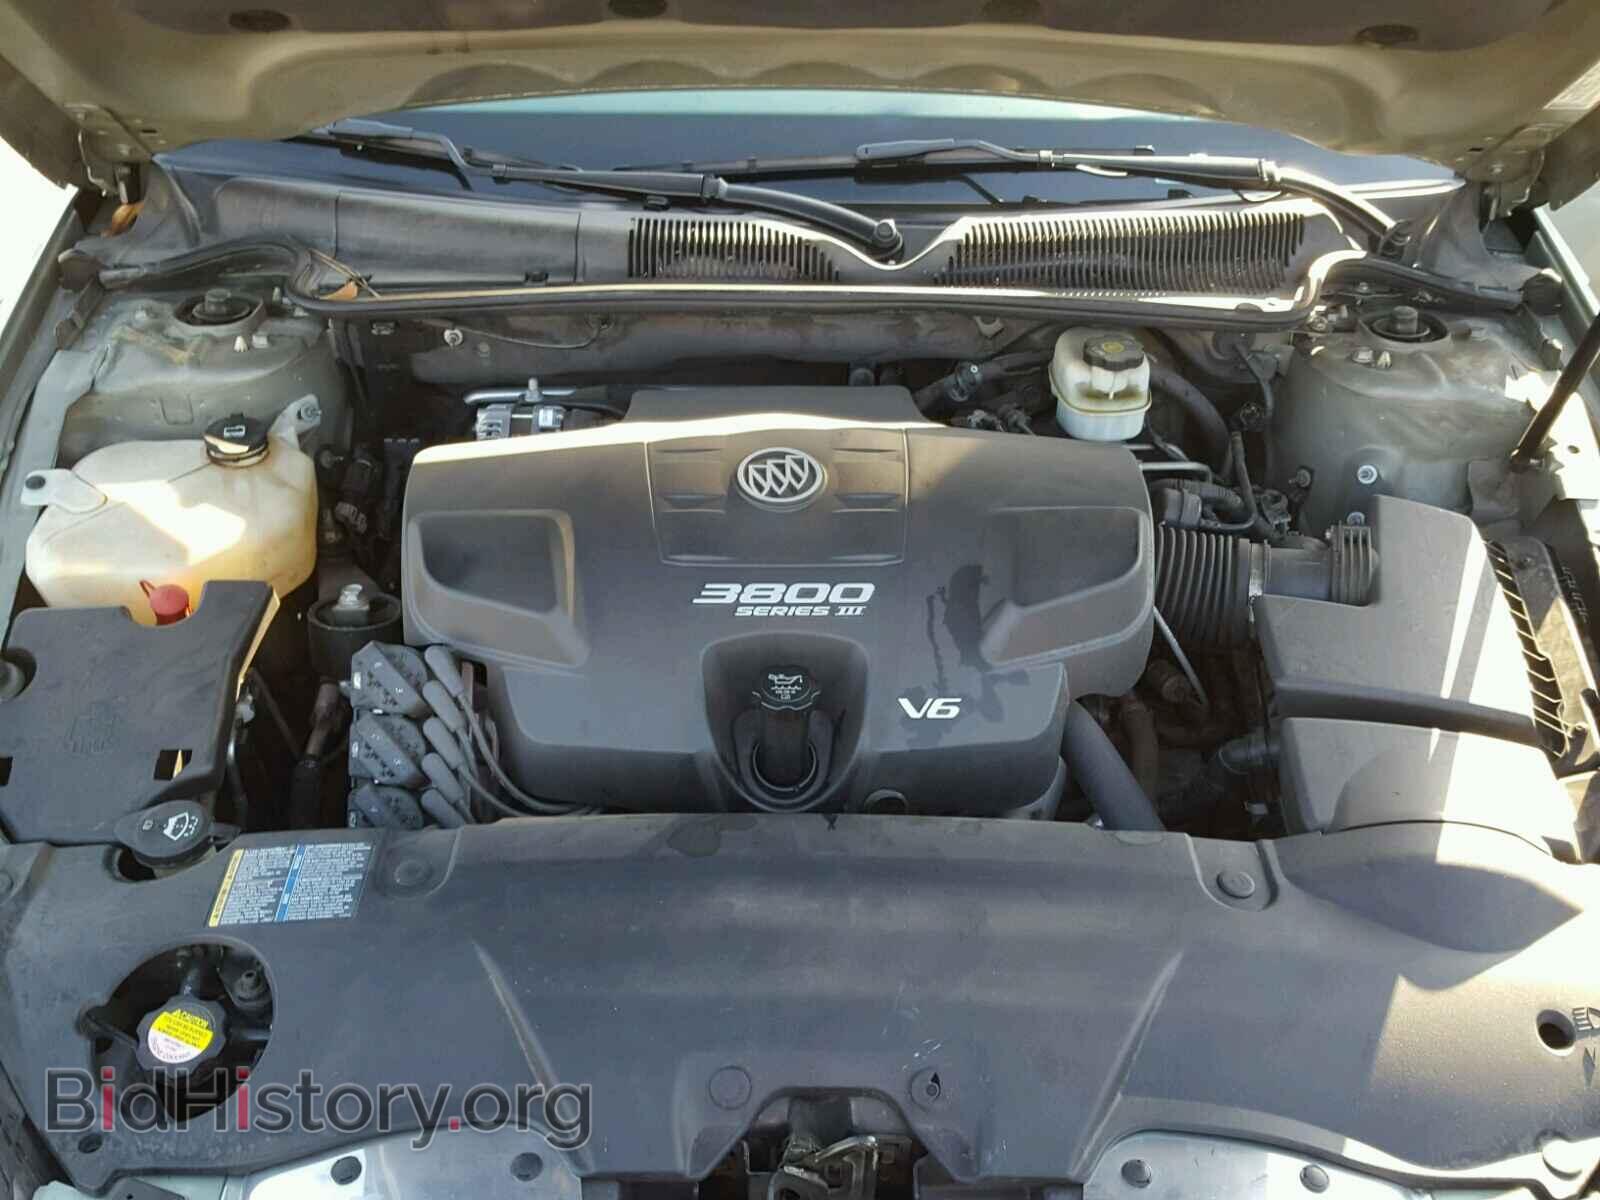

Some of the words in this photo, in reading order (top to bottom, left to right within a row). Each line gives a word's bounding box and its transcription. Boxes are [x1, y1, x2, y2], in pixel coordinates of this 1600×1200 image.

[692, 583, 876, 604] 3800
[734, 605, 831, 617] SERIES
[834, 605, 867, 617] III
[898, 698, 963, 719] V6
